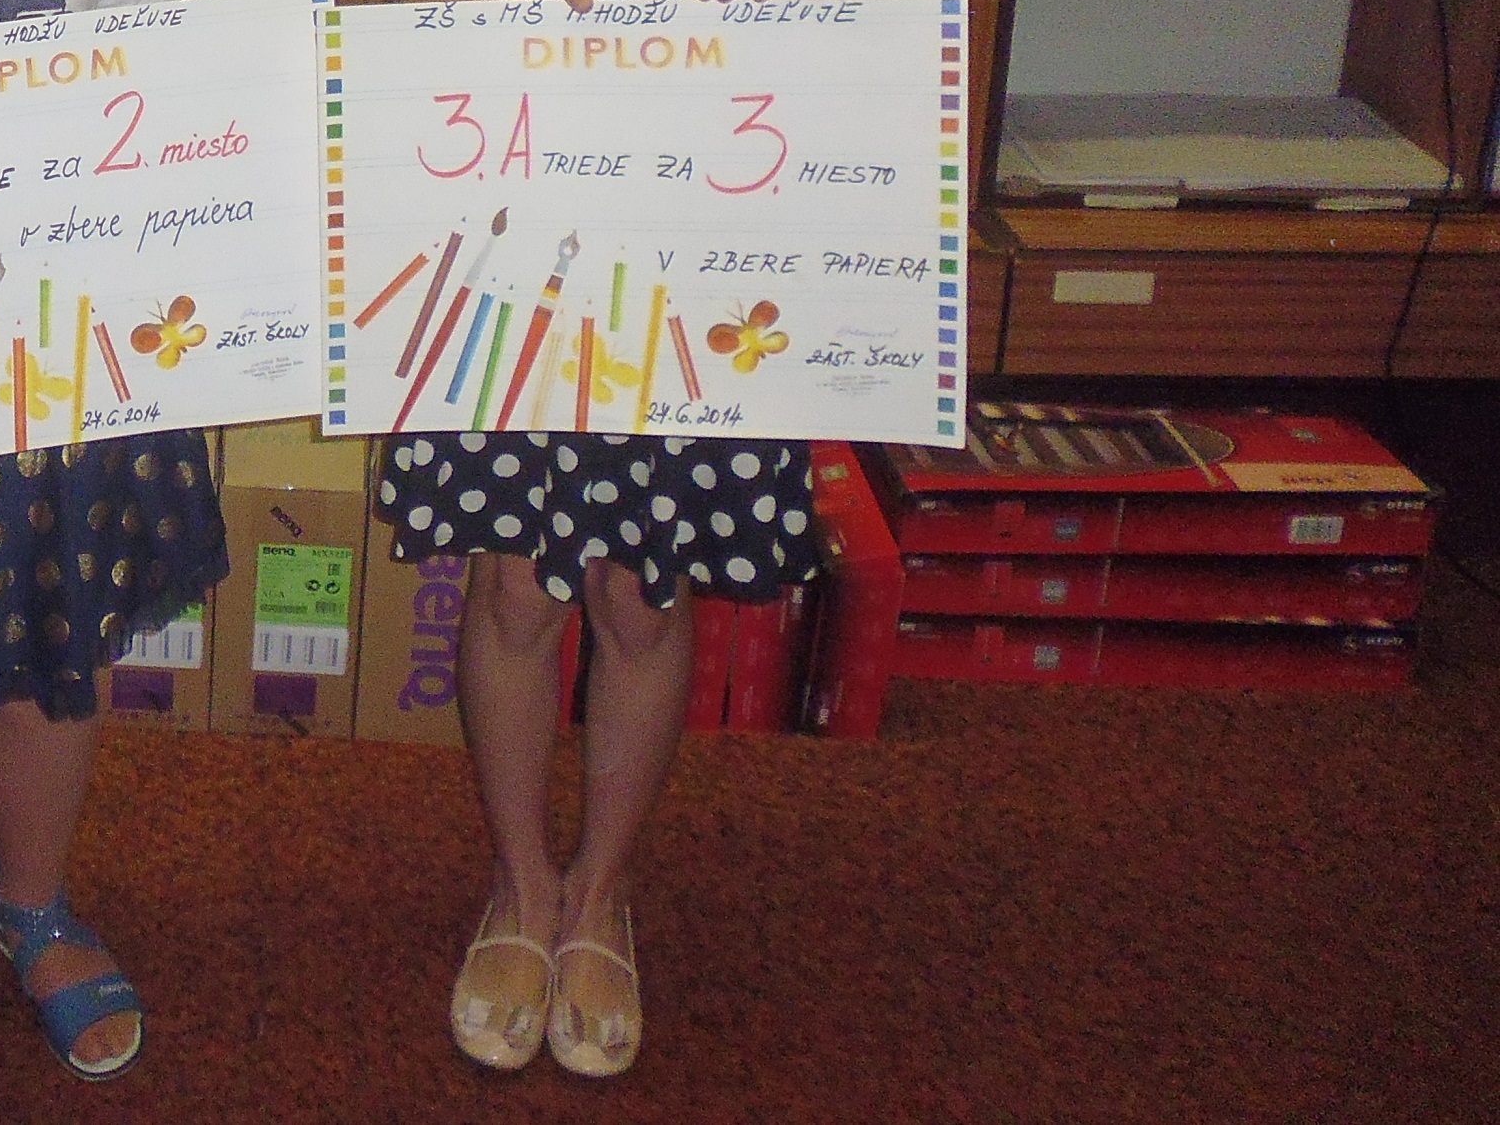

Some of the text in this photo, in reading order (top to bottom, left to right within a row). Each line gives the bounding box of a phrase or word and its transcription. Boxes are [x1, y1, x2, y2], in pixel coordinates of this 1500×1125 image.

[415, 1, 455, 30] ZŠ
[522, 35, 727, 70] DIPLOM
[93, 89, 149, 175] 2.
[159, 120, 250, 168] miesto
[543, 151, 631, 179] TRIEDE
[706, 92, 789, 197] 3.
[798, 160, 897, 186] MIESTO
[48, 205, 125, 243] zbere
[137, 197, 255, 252] papiera
[700, 252, 803, 276] ZBERE
[823, 252, 932, 281] PAPIERA
